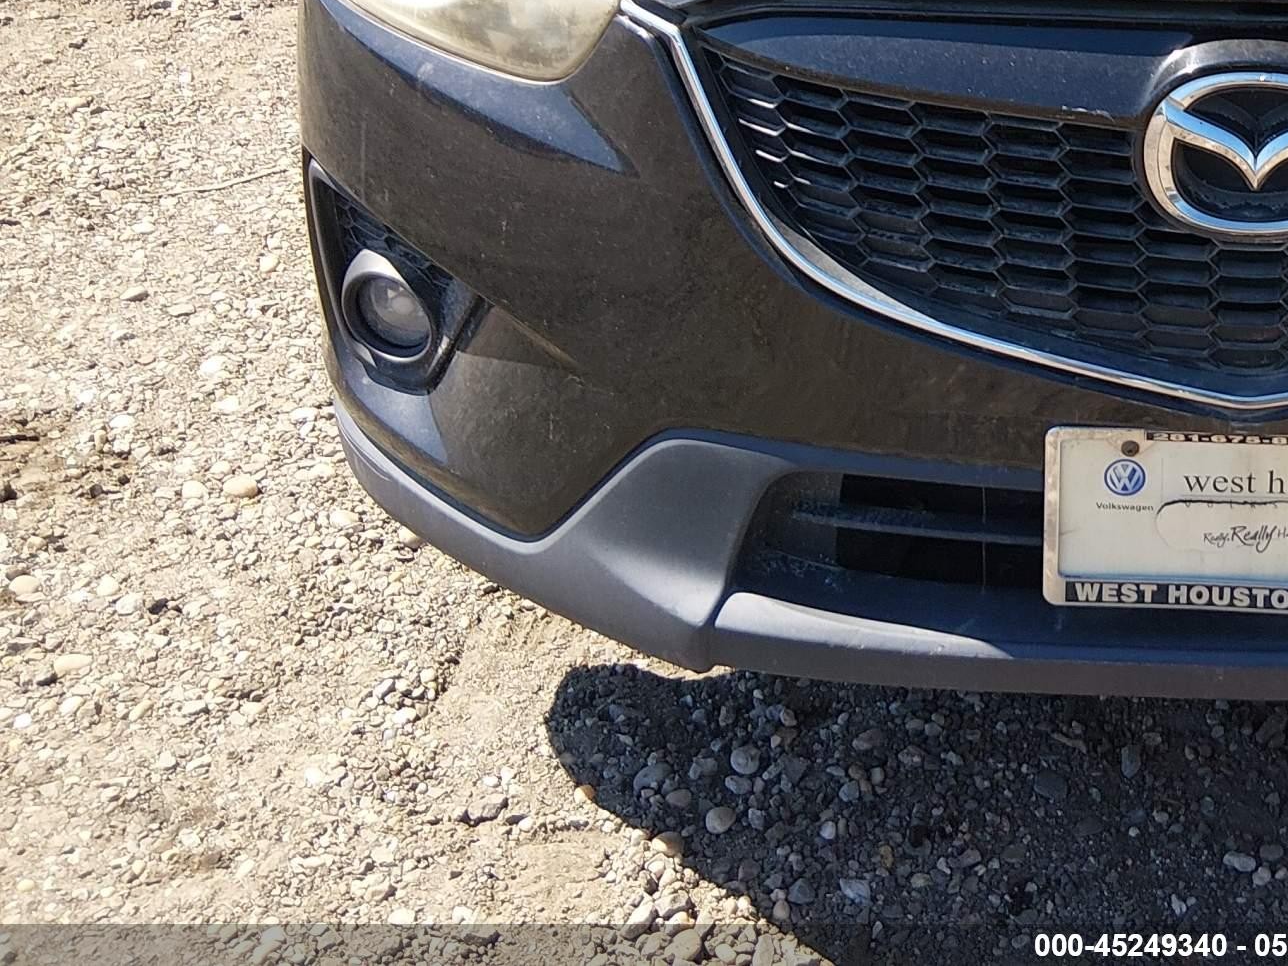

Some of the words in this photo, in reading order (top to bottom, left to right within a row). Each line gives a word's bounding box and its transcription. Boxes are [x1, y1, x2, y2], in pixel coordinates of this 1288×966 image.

[1184, 471, 1257, 494] west
[1096, 501, 1154, 513] Volkswagen
[1230, 525, 1278, 553] Really
[1075, 582, 1158, 603] WEST
